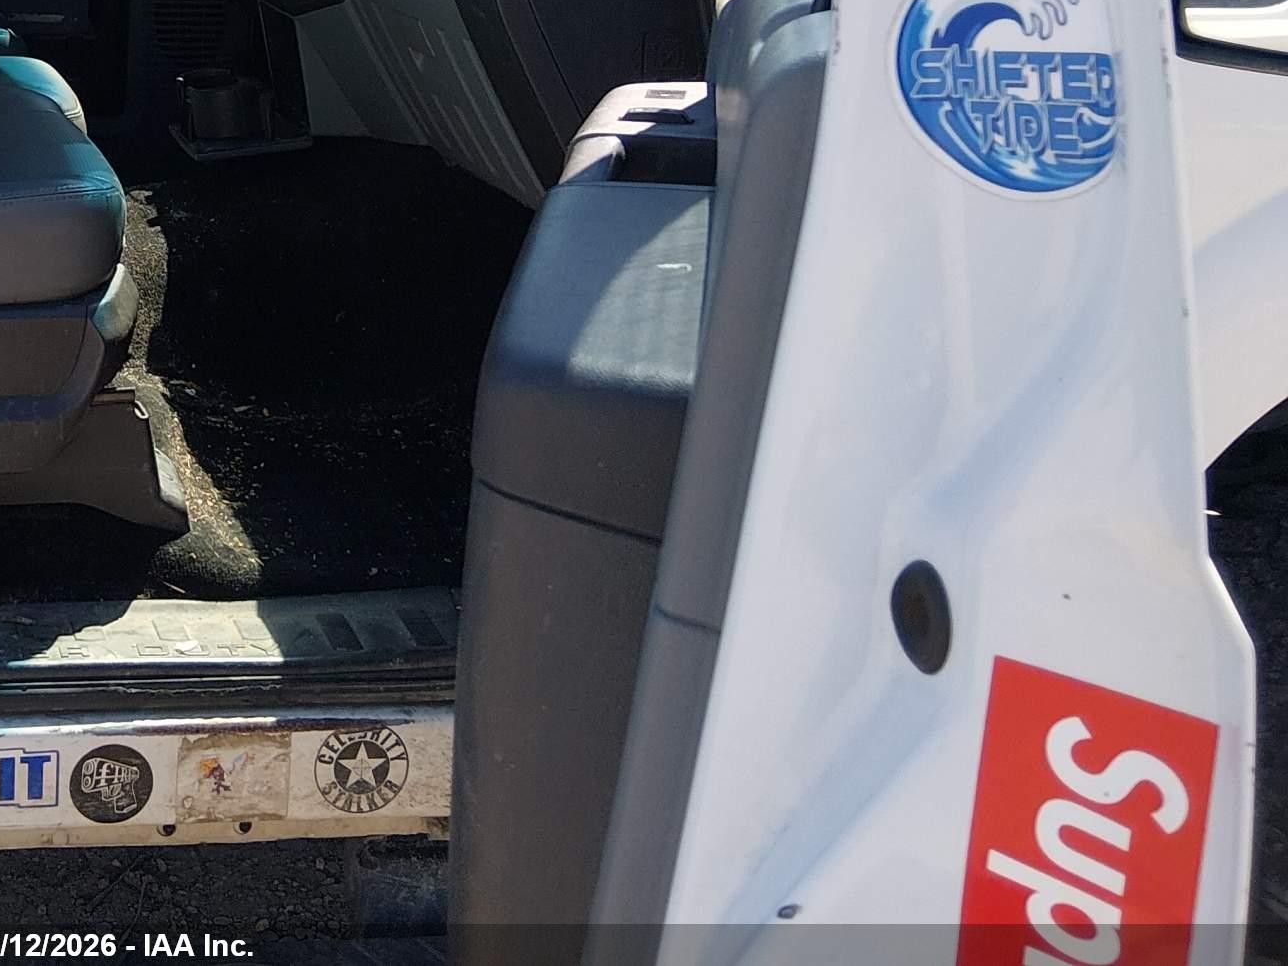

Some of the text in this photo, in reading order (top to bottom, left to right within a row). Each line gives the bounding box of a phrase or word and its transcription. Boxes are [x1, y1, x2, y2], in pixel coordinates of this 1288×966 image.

[910, 45, 1117, 108] SHIFTED
[968, 99, 1083, 157] TIDE
[322, 779, 400, 812] STALKER
[985, 715, 1190, 966] Sup
